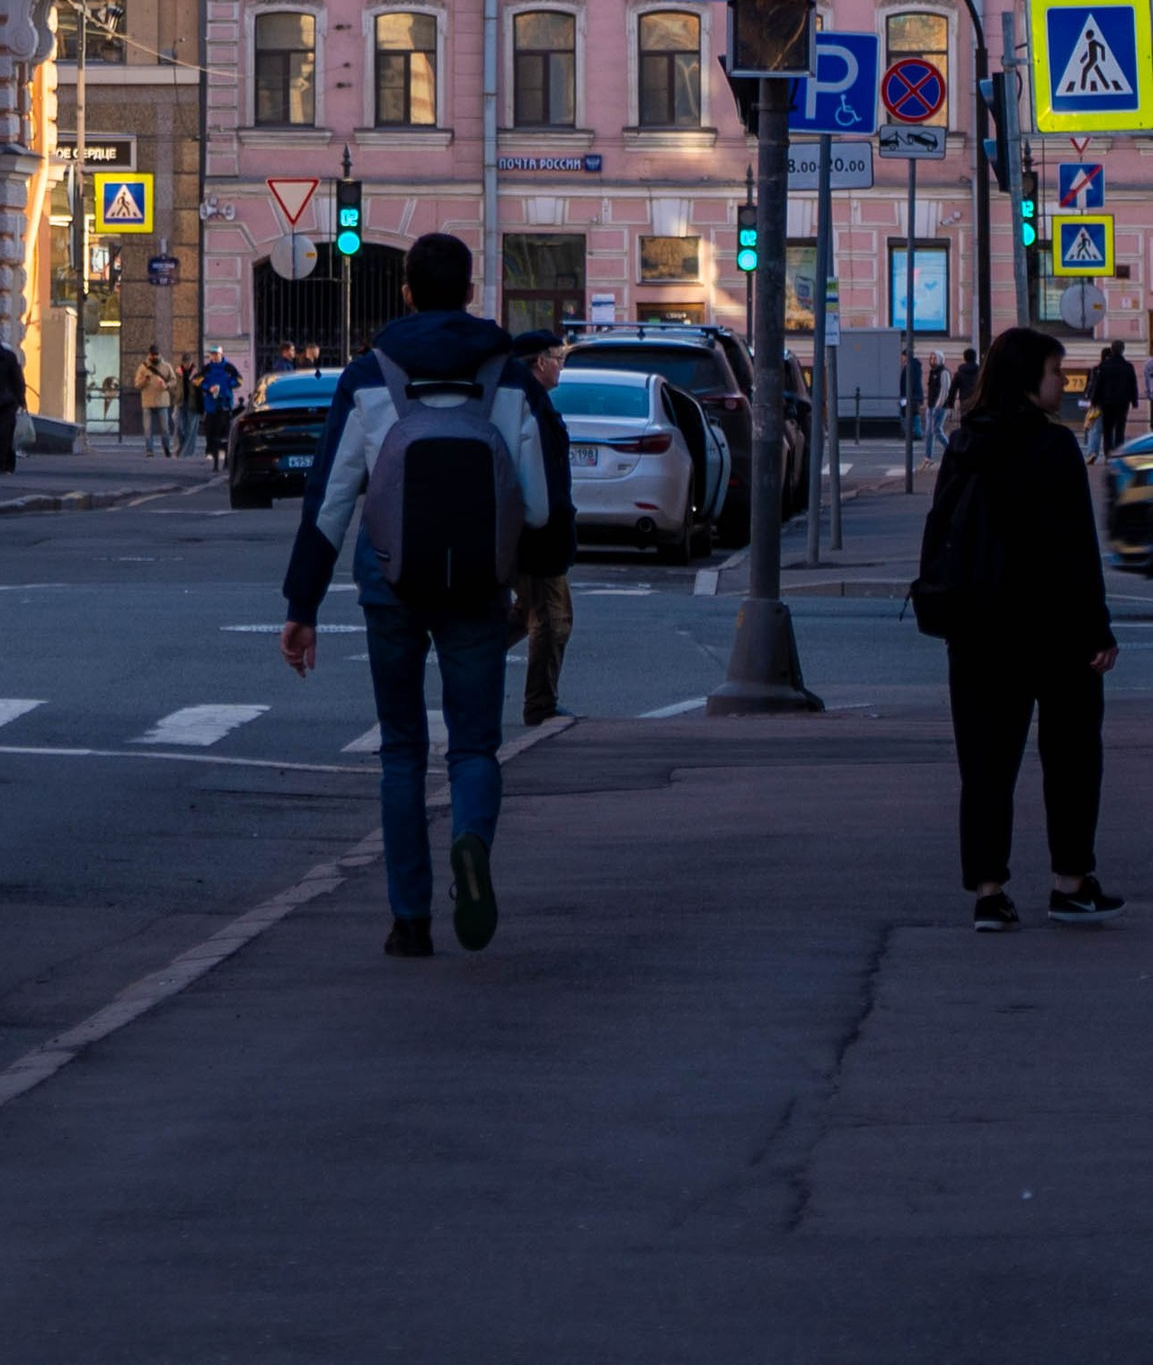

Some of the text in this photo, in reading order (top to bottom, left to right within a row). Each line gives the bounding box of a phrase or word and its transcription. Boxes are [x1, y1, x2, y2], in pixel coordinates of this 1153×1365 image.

[805, 44, 859, 119] P
[499, 157, 581, 170] ПОЧТА РОССИИ
